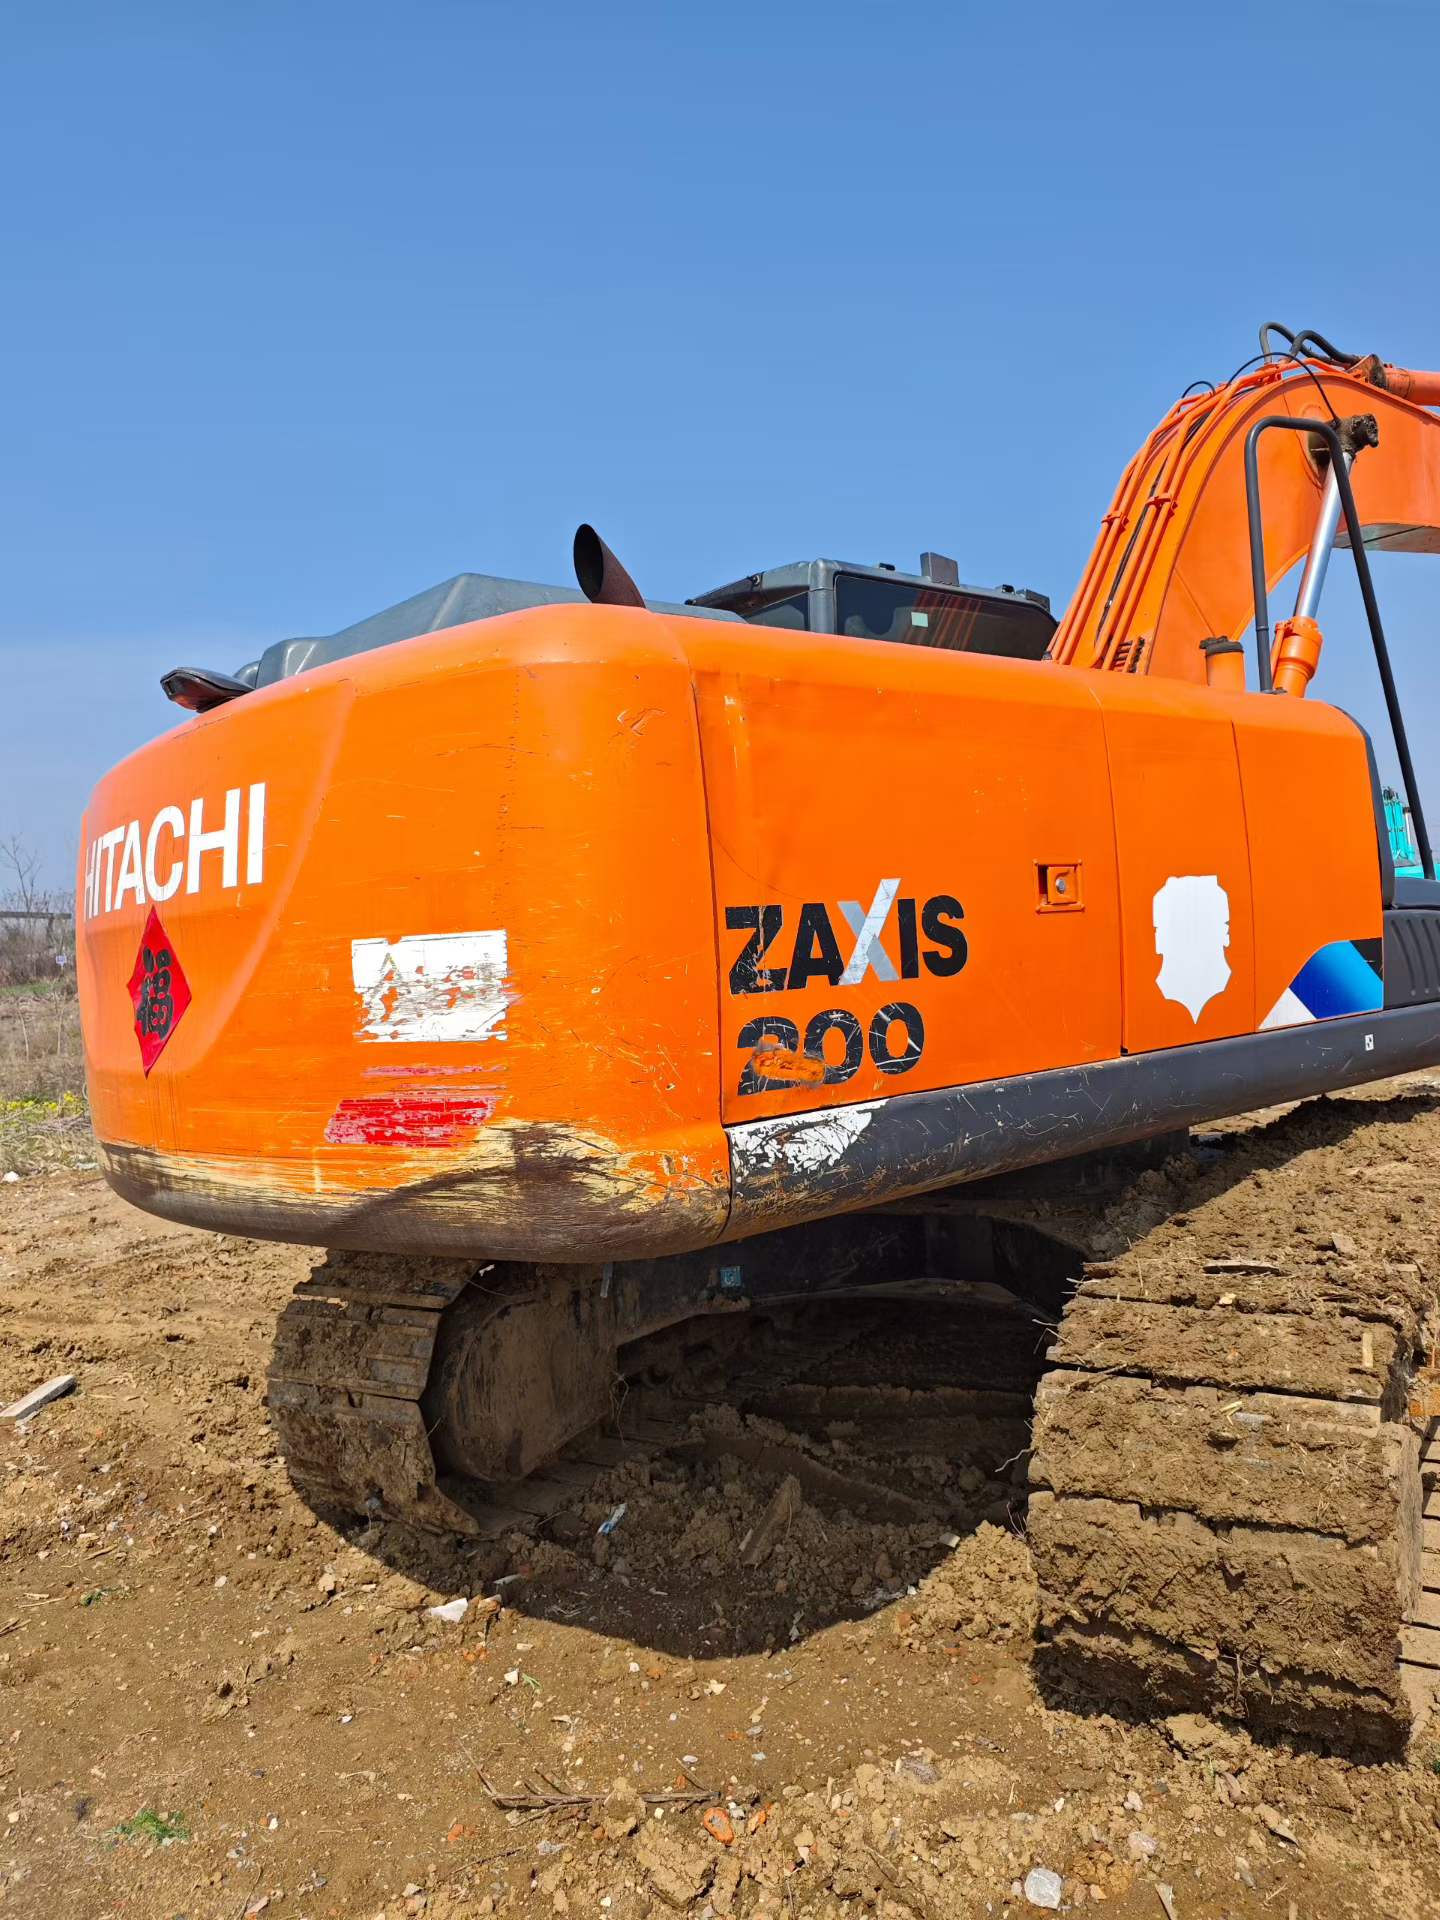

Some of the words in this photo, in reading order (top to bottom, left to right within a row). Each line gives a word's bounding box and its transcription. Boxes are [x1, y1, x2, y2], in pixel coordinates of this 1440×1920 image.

[83, 782, 266, 922] HITACHI
[725, 877, 968, 995] ZAXIS
[136, 946, 174, 1041] 福
[737, 1001, 925, 1097] 200
